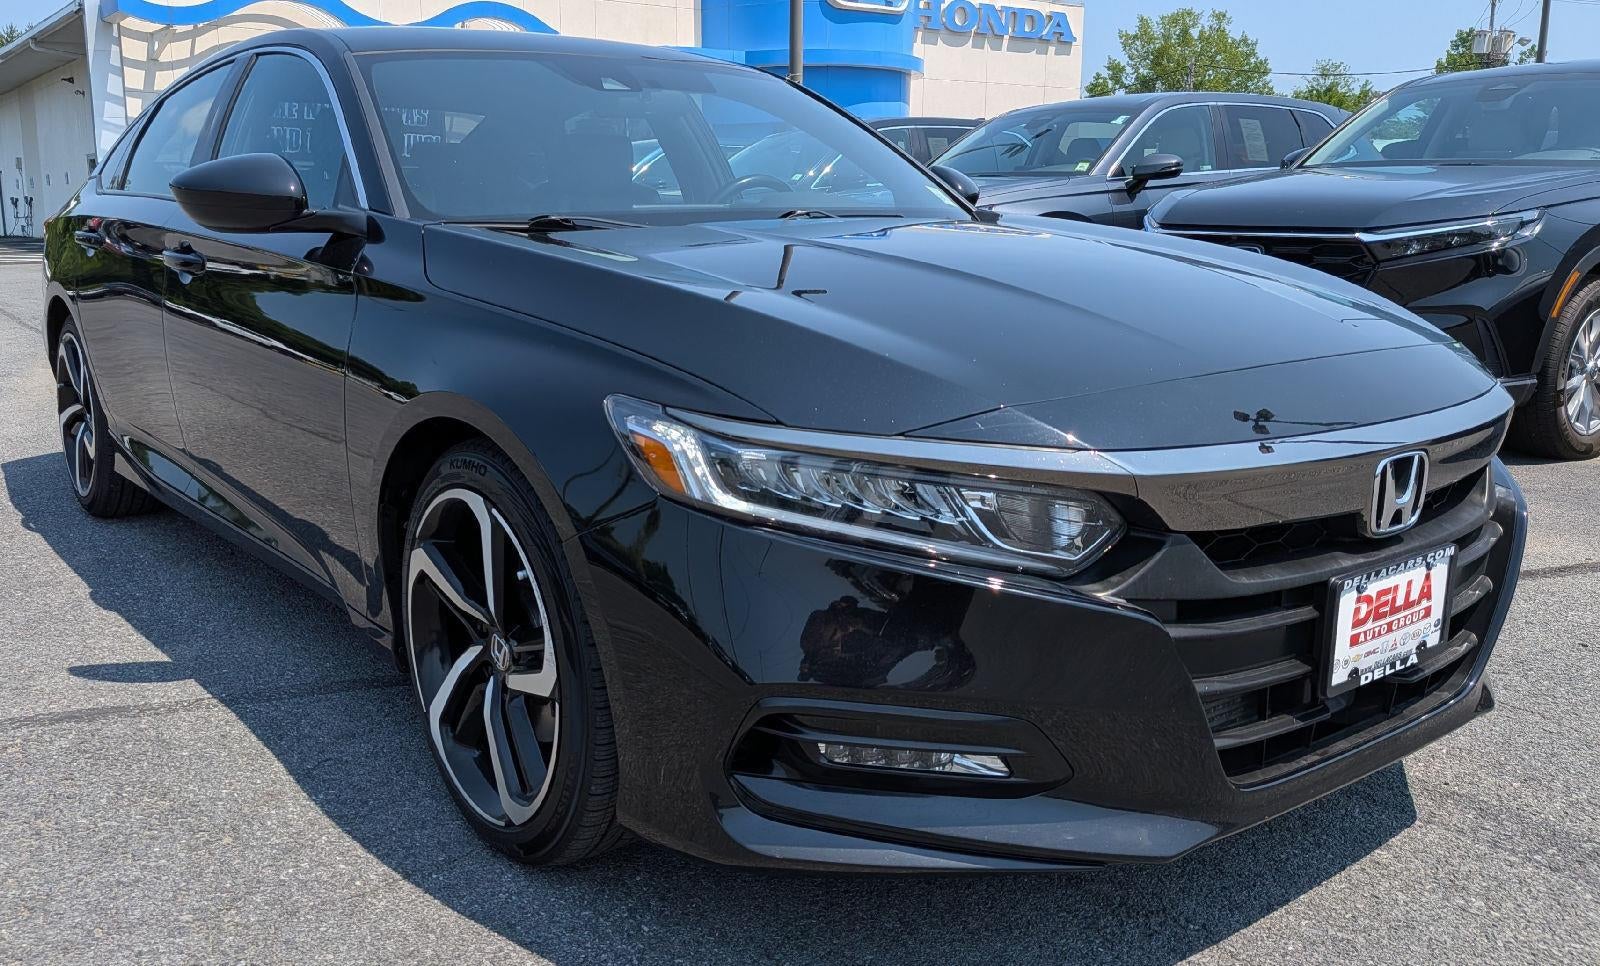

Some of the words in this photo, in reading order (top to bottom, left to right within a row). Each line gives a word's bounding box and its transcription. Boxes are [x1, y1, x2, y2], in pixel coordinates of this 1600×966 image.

[912, 0, 1077, 42] HONDA
[449, 457, 488, 477] KUMHO
[1344, 546, 1456, 591] DELLACARS.COM
[1351, 571, 1433, 631] DELLA
[1358, 626, 1387, 643] AUTO
[1391, 609, 1426, 630] GROUP
[1360, 653, 1419, 686] DELLA
